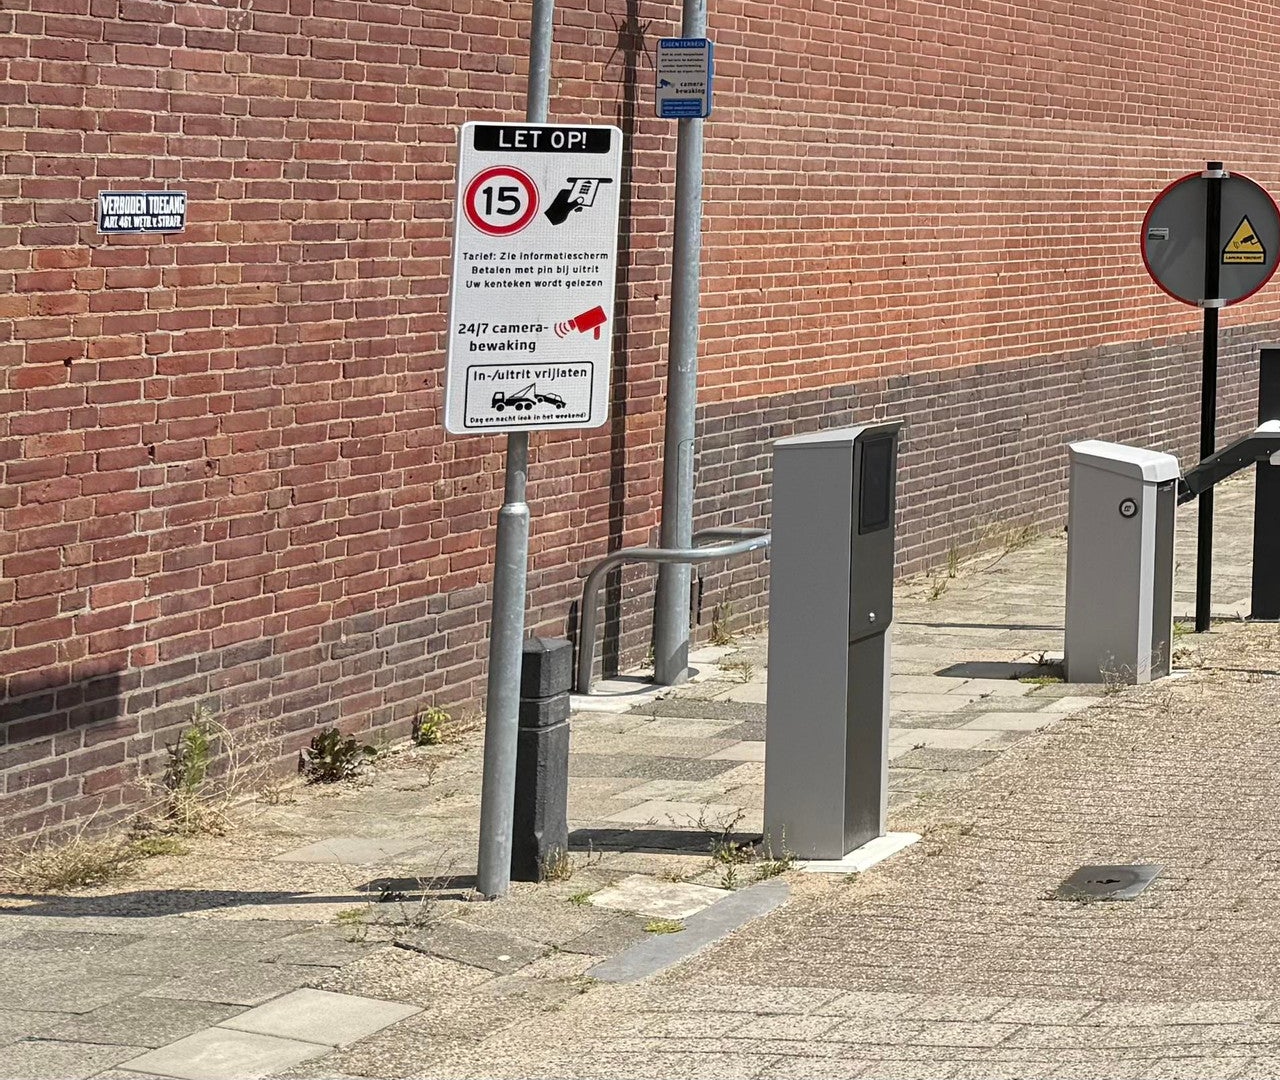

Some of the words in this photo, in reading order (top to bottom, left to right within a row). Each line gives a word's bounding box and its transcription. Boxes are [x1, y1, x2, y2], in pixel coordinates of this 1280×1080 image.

[499, 130, 542, 148] LET
[551, 132, 587, 149] OP!
[101, 196, 146, 215] VERBODEN
[149, 196, 185, 214] TOEGANG
[482, 187, 521, 215] 15
[463, 252, 496, 260] Tarief:
[500, 252, 516, 260] Zie
[520, 252, 608, 260] informatiescherm
[472, 266, 510, 274] Betalen
[537, 266, 552, 275] pin
[557, 266, 568, 275] bij
[484, 280, 530, 288] kenteken
[565, 280, 602, 288] gelezen
[458, 323, 489, 337] 24/7
[492, 323, 549, 334] camera-
[469, 340, 536, 353] bewaking
[474, 370, 530, 381] In-/uitrit
[535, 368, 587, 381] vrijlaten
